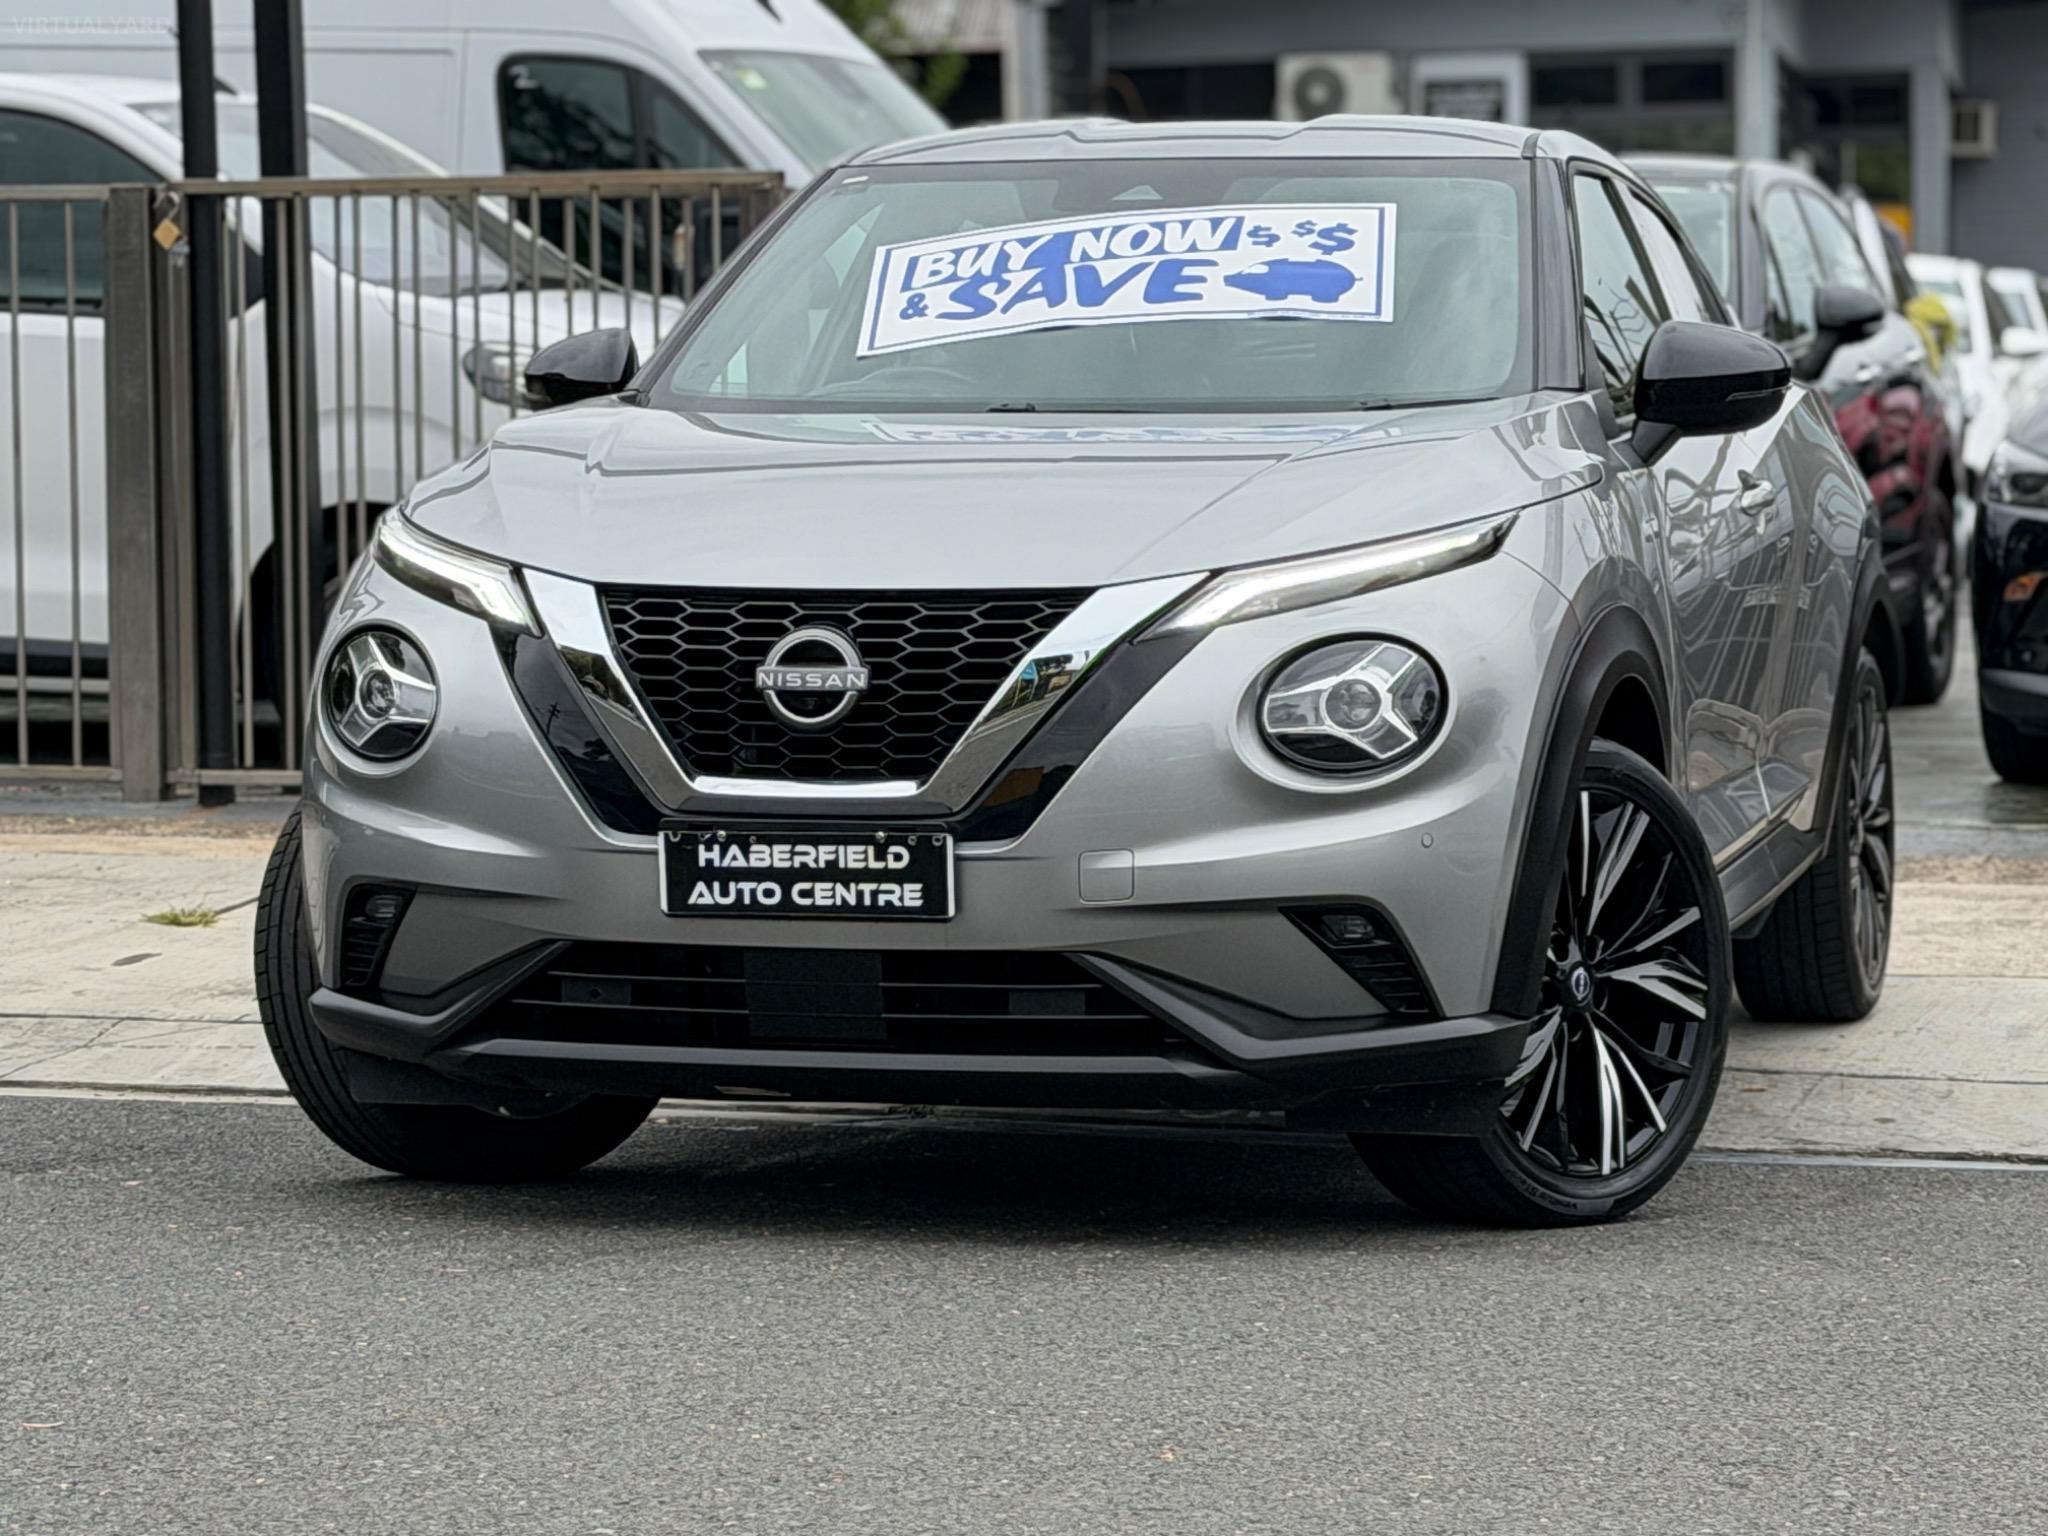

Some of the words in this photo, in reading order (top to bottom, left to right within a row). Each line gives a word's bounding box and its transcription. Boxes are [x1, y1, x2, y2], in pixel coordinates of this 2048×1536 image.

[911, 234, 1055, 289] BUY
[1069, 217, 1237, 263] NOW
[899, 292, 929, 320] &
[935, 258, 1220, 320] SAVE
[757, 671, 867, 688] NISSAN
[698, 843, 911, 870] HABERFIELD
[687, 881, 782, 905] AUTO
[791, 882, 924, 907] CENTRE
